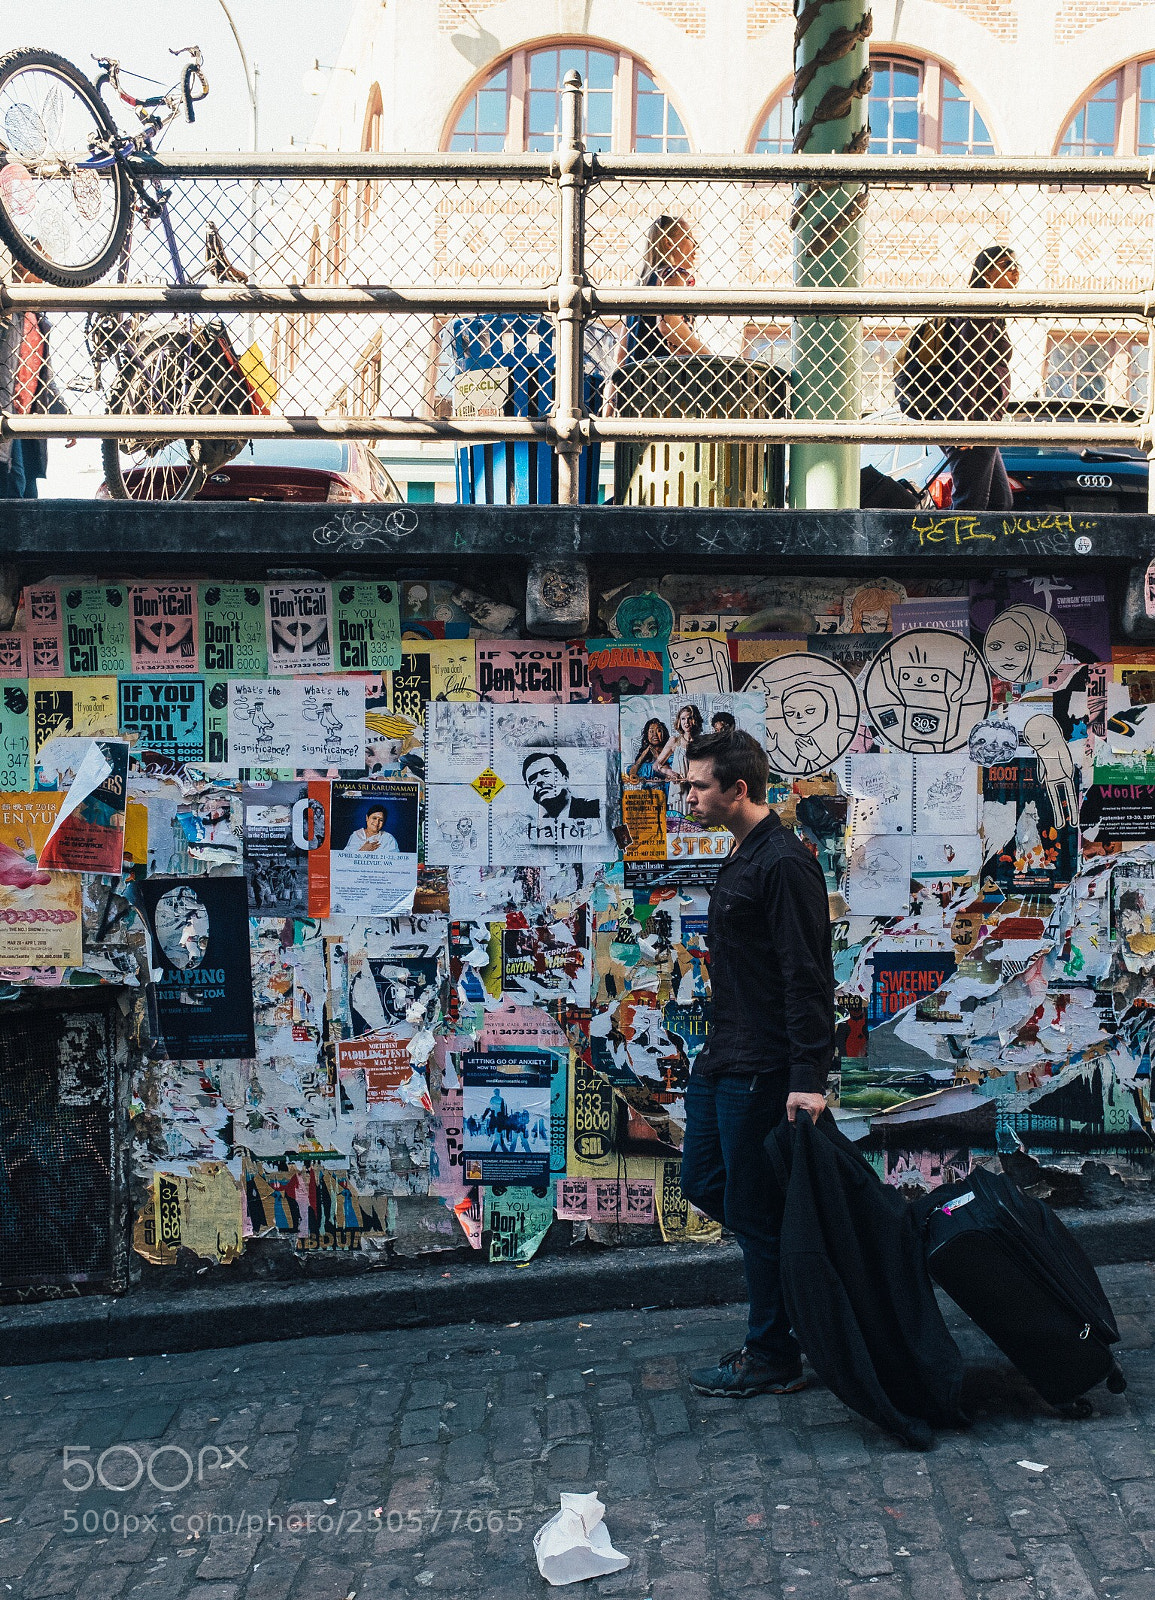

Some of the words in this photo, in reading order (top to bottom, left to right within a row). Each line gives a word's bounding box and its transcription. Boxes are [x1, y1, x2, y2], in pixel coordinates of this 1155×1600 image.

[67, 614, 76, 623] IF
[83, 613, 106, 622] YOU
[204, 612, 214, 620] IF
[220, 612, 244, 620] YOU
[338, 610, 348, 618] IF
[354, 609, 377, 618] YOU
[339, 619, 374, 641] Don't
[926, 620, 968, 628] CONCERT
[68, 623, 104, 646] Don't
[204, 621, 240, 643] Don't
[246, 633, 262, 644] 347
[380, 630, 395, 640] 347
[110, 634, 124, 644] 347
[69, 646, 98, 672] Call
[204, 644, 234, 670] Call
[340, 641, 368, 667] Call
[508, 651, 562, 660] YOU
[588, 648, 663, 672] GORILLA
[102, 660, 124, 670] 6000
[238, 658, 261, 670] 6000
[372, 656, 394, 667] 6000
[123, 686, 142, 702] IF
[148, 686, 195, 702] YOU
[235, 686, 263, 695] What's
[267, 685, 281, 695] the
[304, 686, 332, 696] What's
[337, 686, 350, 696] the
[82, 704, 92, 714] you
[123, 705, 191, 722] DON'T
[209, 718, 221, 730] IF
[912, 716, 937, 732] 805
[4, 736, 29, 751] (+1)
[234, 743, 290, 756] significance?
[302, 744, 359, 757] significance?
[7, 753, 29, 768] 347
[989, 766, 1018, 781] HOOT
[372, 784, 417, 792] KARUNAMAYI
[528, 821, 586, 839] traitor
[880, 970, 944, 992] SWEENEY
[576, 1111, 610, 1130] 6000
[582, 1138, 603, 1155] SOL
[491, 1203, 500, 1211] IF
[506, 1203, 530, 1211] YOU
[664, 1199, 687, 1212] 6000
[491, 1211, 526, 1232] Don't
[532, 1224, 546, 1233] 347
